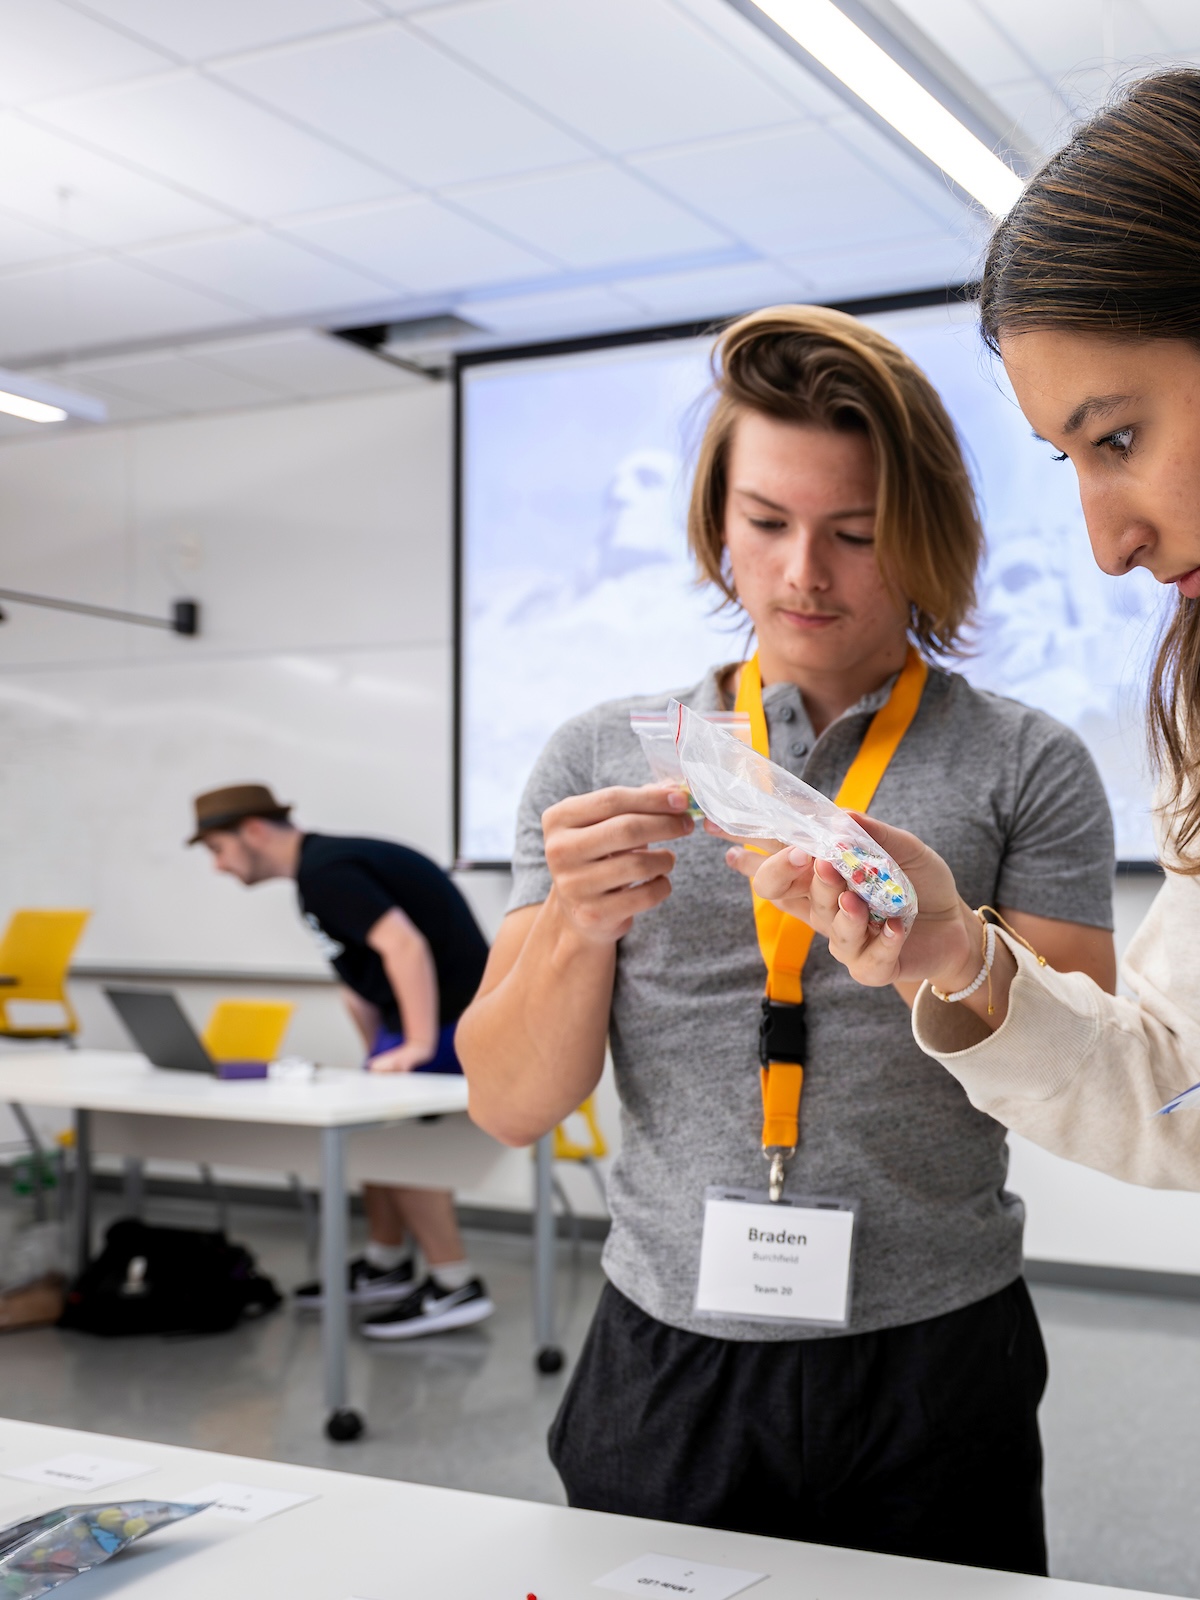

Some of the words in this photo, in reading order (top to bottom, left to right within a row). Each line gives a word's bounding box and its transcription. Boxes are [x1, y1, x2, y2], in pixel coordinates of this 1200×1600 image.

[747, 1227, 808, 1246] Braden
[752, 1251, 800, 1265] Burchfield
[753, 1283, 779, 1295] Team
[780, 1285, 794, 1297] 20
